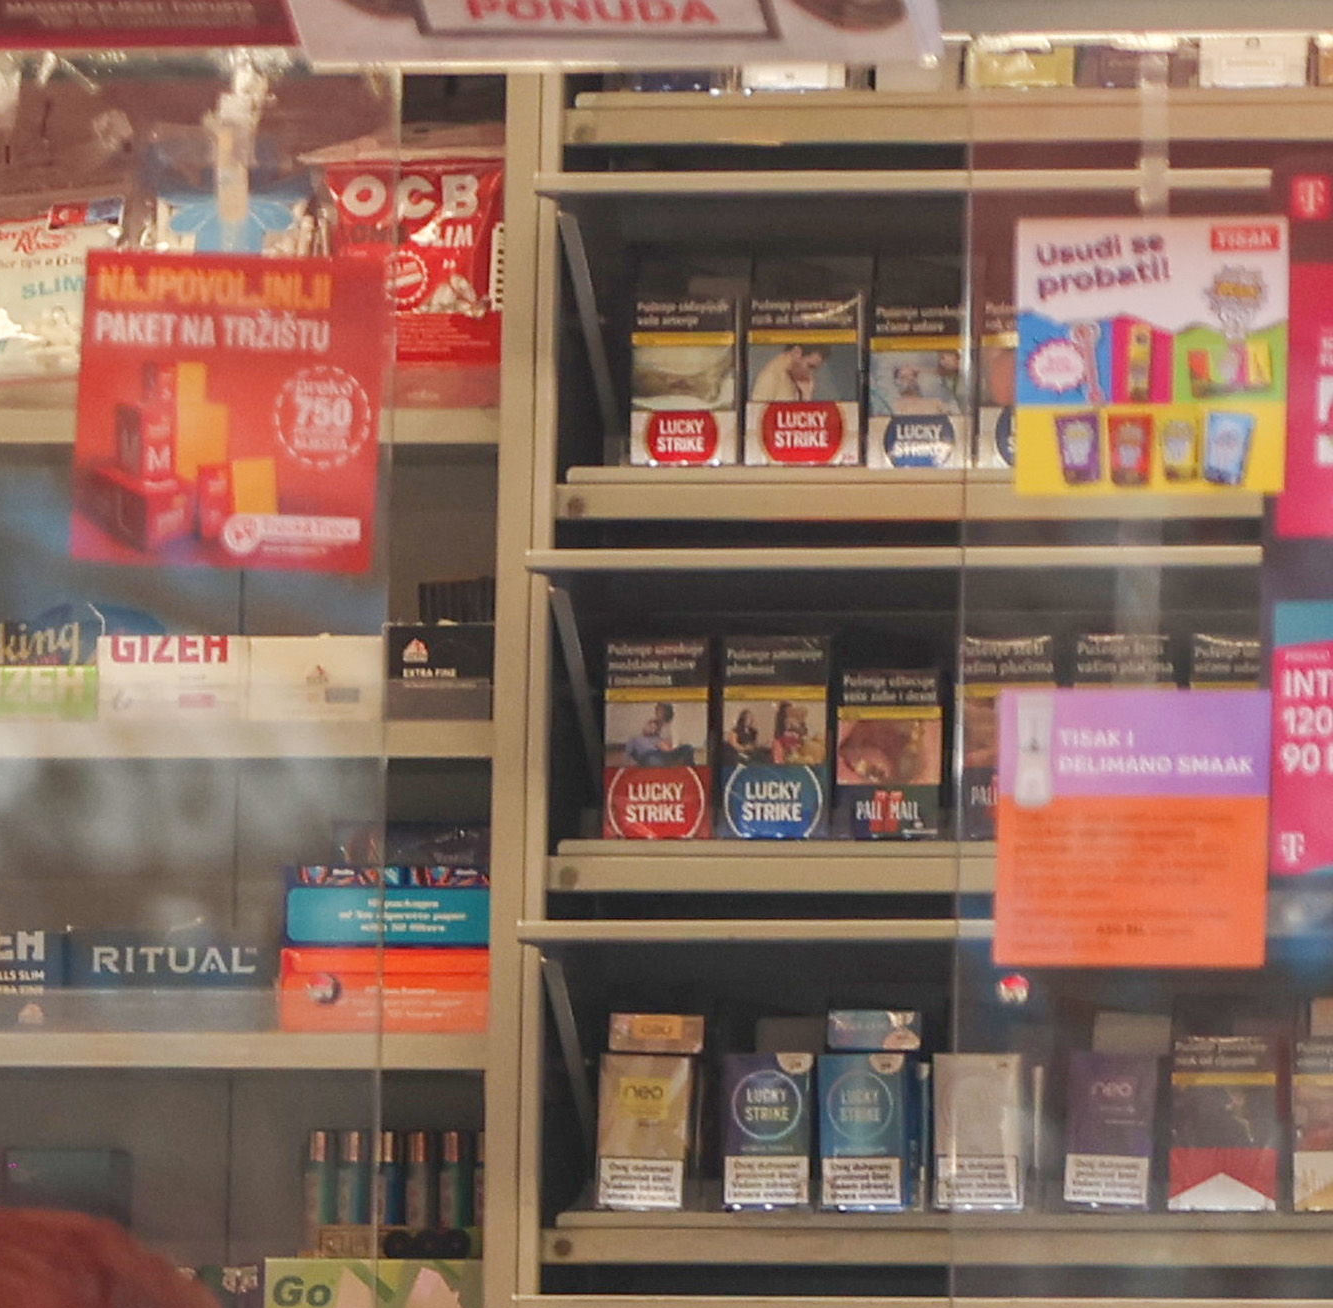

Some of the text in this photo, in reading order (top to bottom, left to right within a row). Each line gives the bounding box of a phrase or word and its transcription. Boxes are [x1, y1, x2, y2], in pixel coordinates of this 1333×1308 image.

[468, 0, 719, 25] PONUDA
[341, 174, 480, 220] OCB
[1036, 233, 1165, 267] Usudi se
[22, 276, 85, 300] SLIM
[1037, 257, 1170, 301] probati!
[94, 308, 331, 352] PAKET NA TRŽIŠTU
[294, 400, 352, 427] 750
[776, 410, 826, 429] LUCKY
[659, 418, 704, 437] LUCKY
[895, 424, 944, 442] LUCKY
[656, 434, 705, 454] STRIKE
[774, 430, 828, 449] STRIKE
[110, 635, 228, 664] GIZEH
[1059, 729, 1120, 747] TISAK
[1059, 756, 1254, 774] DELIMANO SMAAK
[1281, 745, 1323, 773] 90
[627, 782, 684, 802] LUCKY
[745, 781, 802, 801] LUCKY
[625, 803, 685, 823] STRIKE
[741, 803, 802, 822] STRIKE
[856, 800, 920, 821] PALL MALL
[93, 944, 256, 975] RITUAL
[17, 969, 45, 981] SLIM
[621, 1086, 664, 1099] neo
[746, 1088, 786, 1103] LUCKY
[744, 1107, 790, 1122] STRIKE
[273, 1275, 332, 1308] Go
